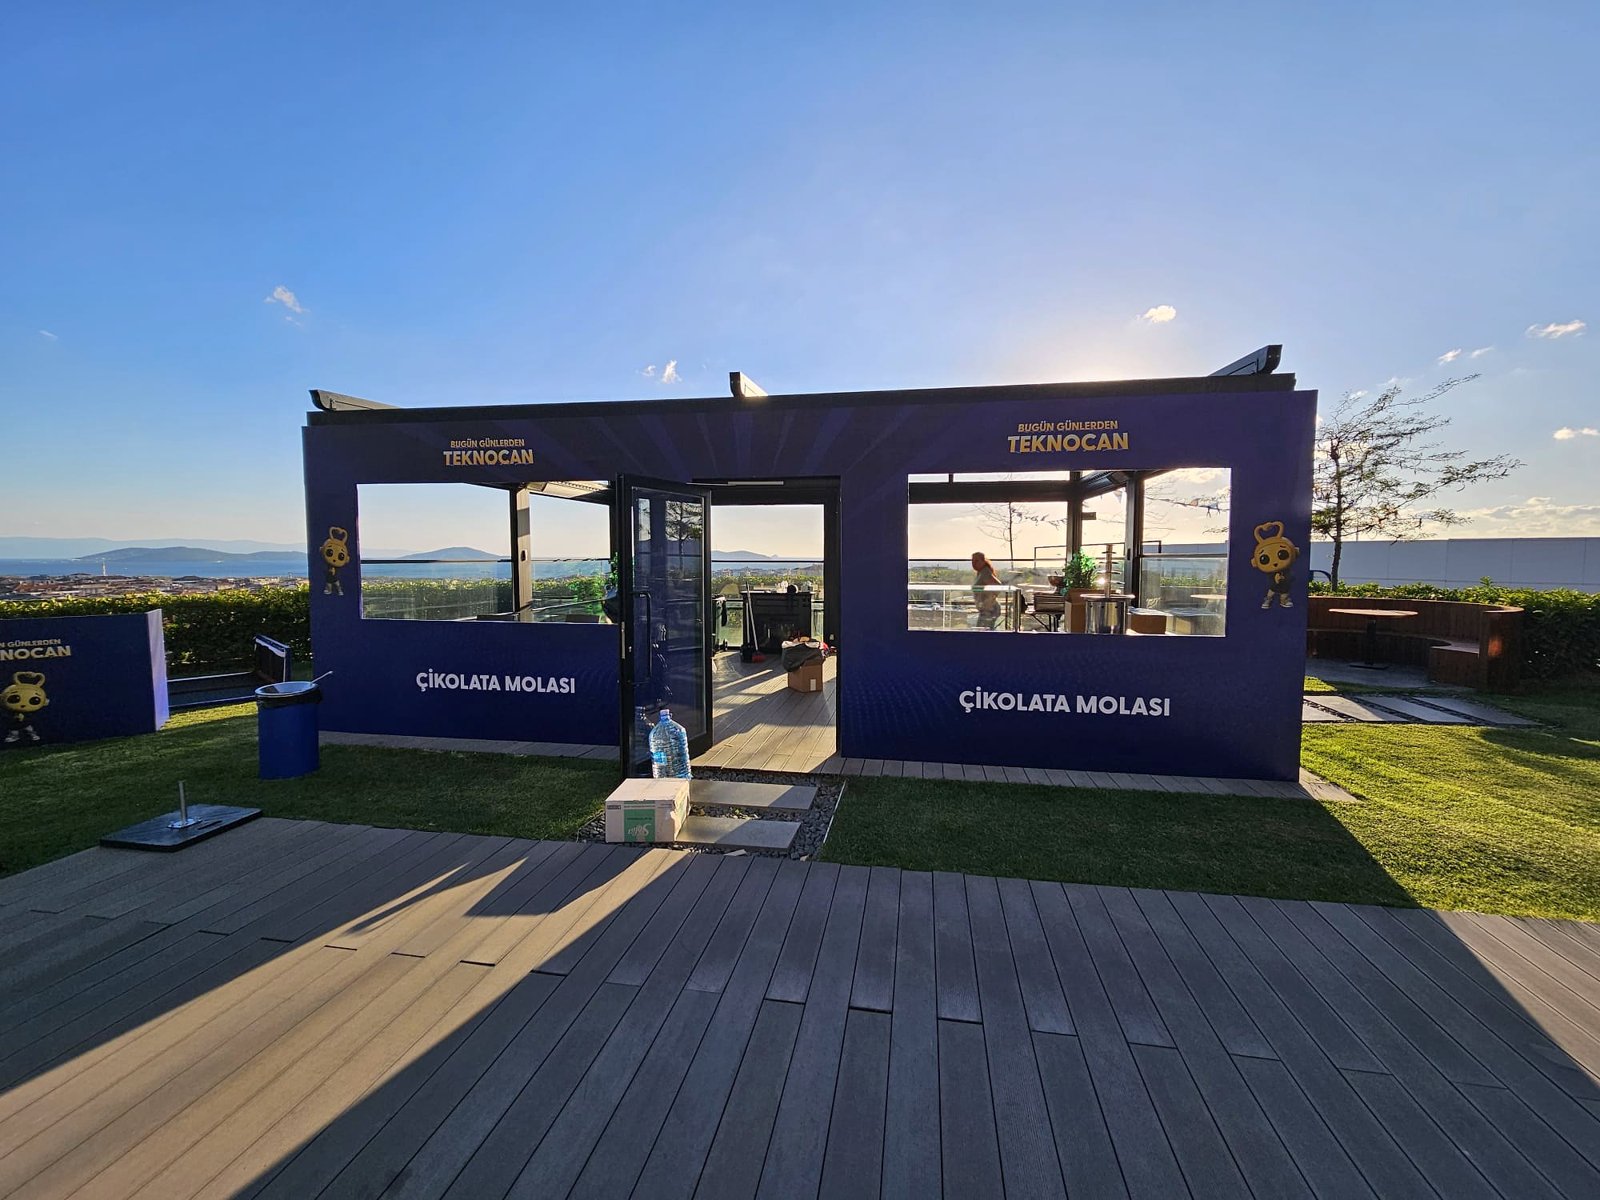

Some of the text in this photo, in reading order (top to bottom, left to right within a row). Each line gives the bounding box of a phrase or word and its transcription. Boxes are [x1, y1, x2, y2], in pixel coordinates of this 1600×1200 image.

[1017, 419, 1118, 433] BUGÜN GÜNLERDEN
[450, 437, 525, 448] BUGÜN GÜNLERDEN
[1007, 432, 1129, 453] TEKNOCAN
[442, 449, 534, 466] TEKNOCAN
[416, 668, 576, 694] ÇİKOLATA MOLASI
[959, 686, 1170, 717] ÇİKOLATA MOLASI
